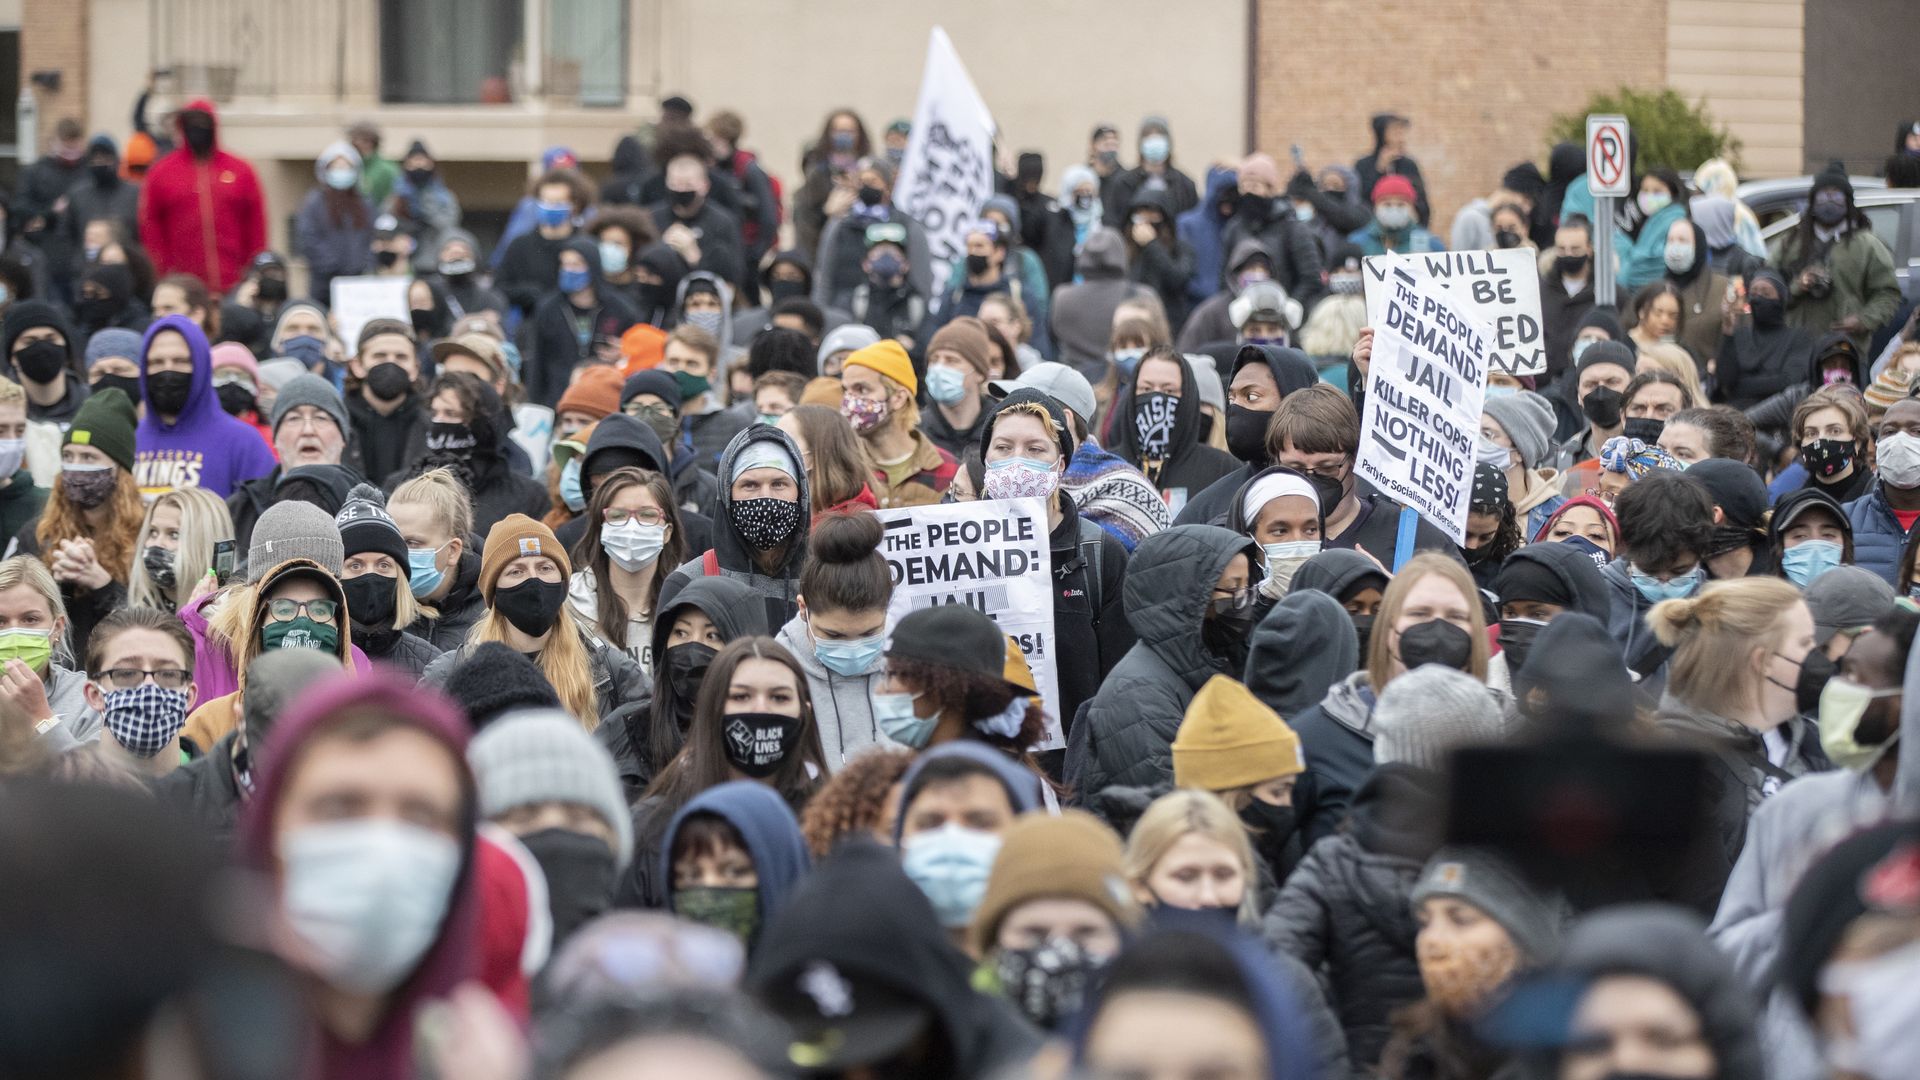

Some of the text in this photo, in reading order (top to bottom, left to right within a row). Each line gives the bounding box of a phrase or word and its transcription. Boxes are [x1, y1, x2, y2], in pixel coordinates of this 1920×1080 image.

[1425, 252, 1507, 278] WILL
[1472, 279, 1516, 304] BE
[1386, 300, 1481, 388] DEMAND:
[1396, 282, 1483, 360] THE PEOPLE
[1405, 356, 1452, 408] JAIL
[1374, 375, 1472, 459] KILLER COPS!
[1375, 404, 1464, 482] NOTHING
[1391, 480, 1431, 507] Socialism
[1433, 508, 1461, 536] Liberation
[1410, 457, 1460, 515] LESS!
[884, 517, 1033, 552] THE PEOPLE
[889, 549, 1039, 585] DEMAND:
[755, 740, 780, 753] LIVES
[756, 726, 783, 740] BLACK
